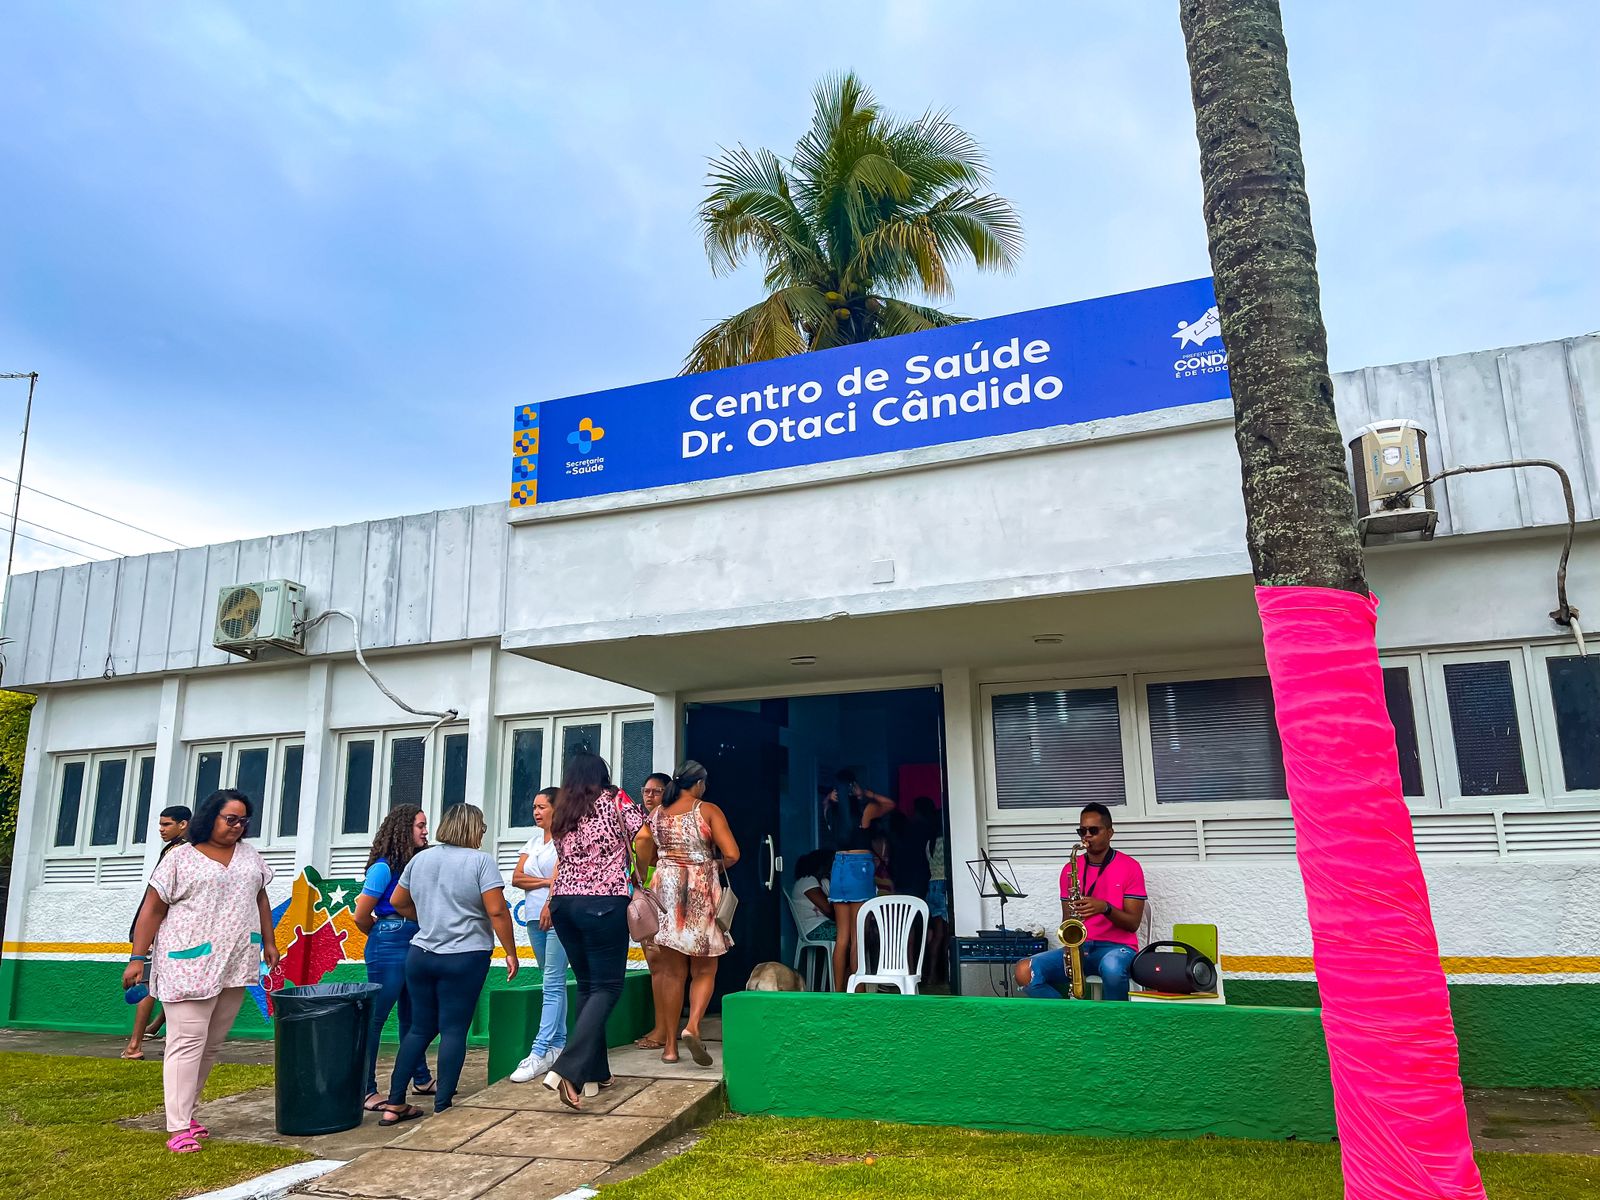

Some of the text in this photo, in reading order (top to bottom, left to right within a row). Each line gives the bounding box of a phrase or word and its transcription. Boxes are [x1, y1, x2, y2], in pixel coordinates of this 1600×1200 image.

[1201, 365, 1229, 374] TODO
[689, 337, 1051, 422] Centro de Saúde
[682, 373, 1064, 459] Dr. Otaci Cândido
[565, 456, 604, 468] Secretaria
[572, 463, 604, 475] Saúde
